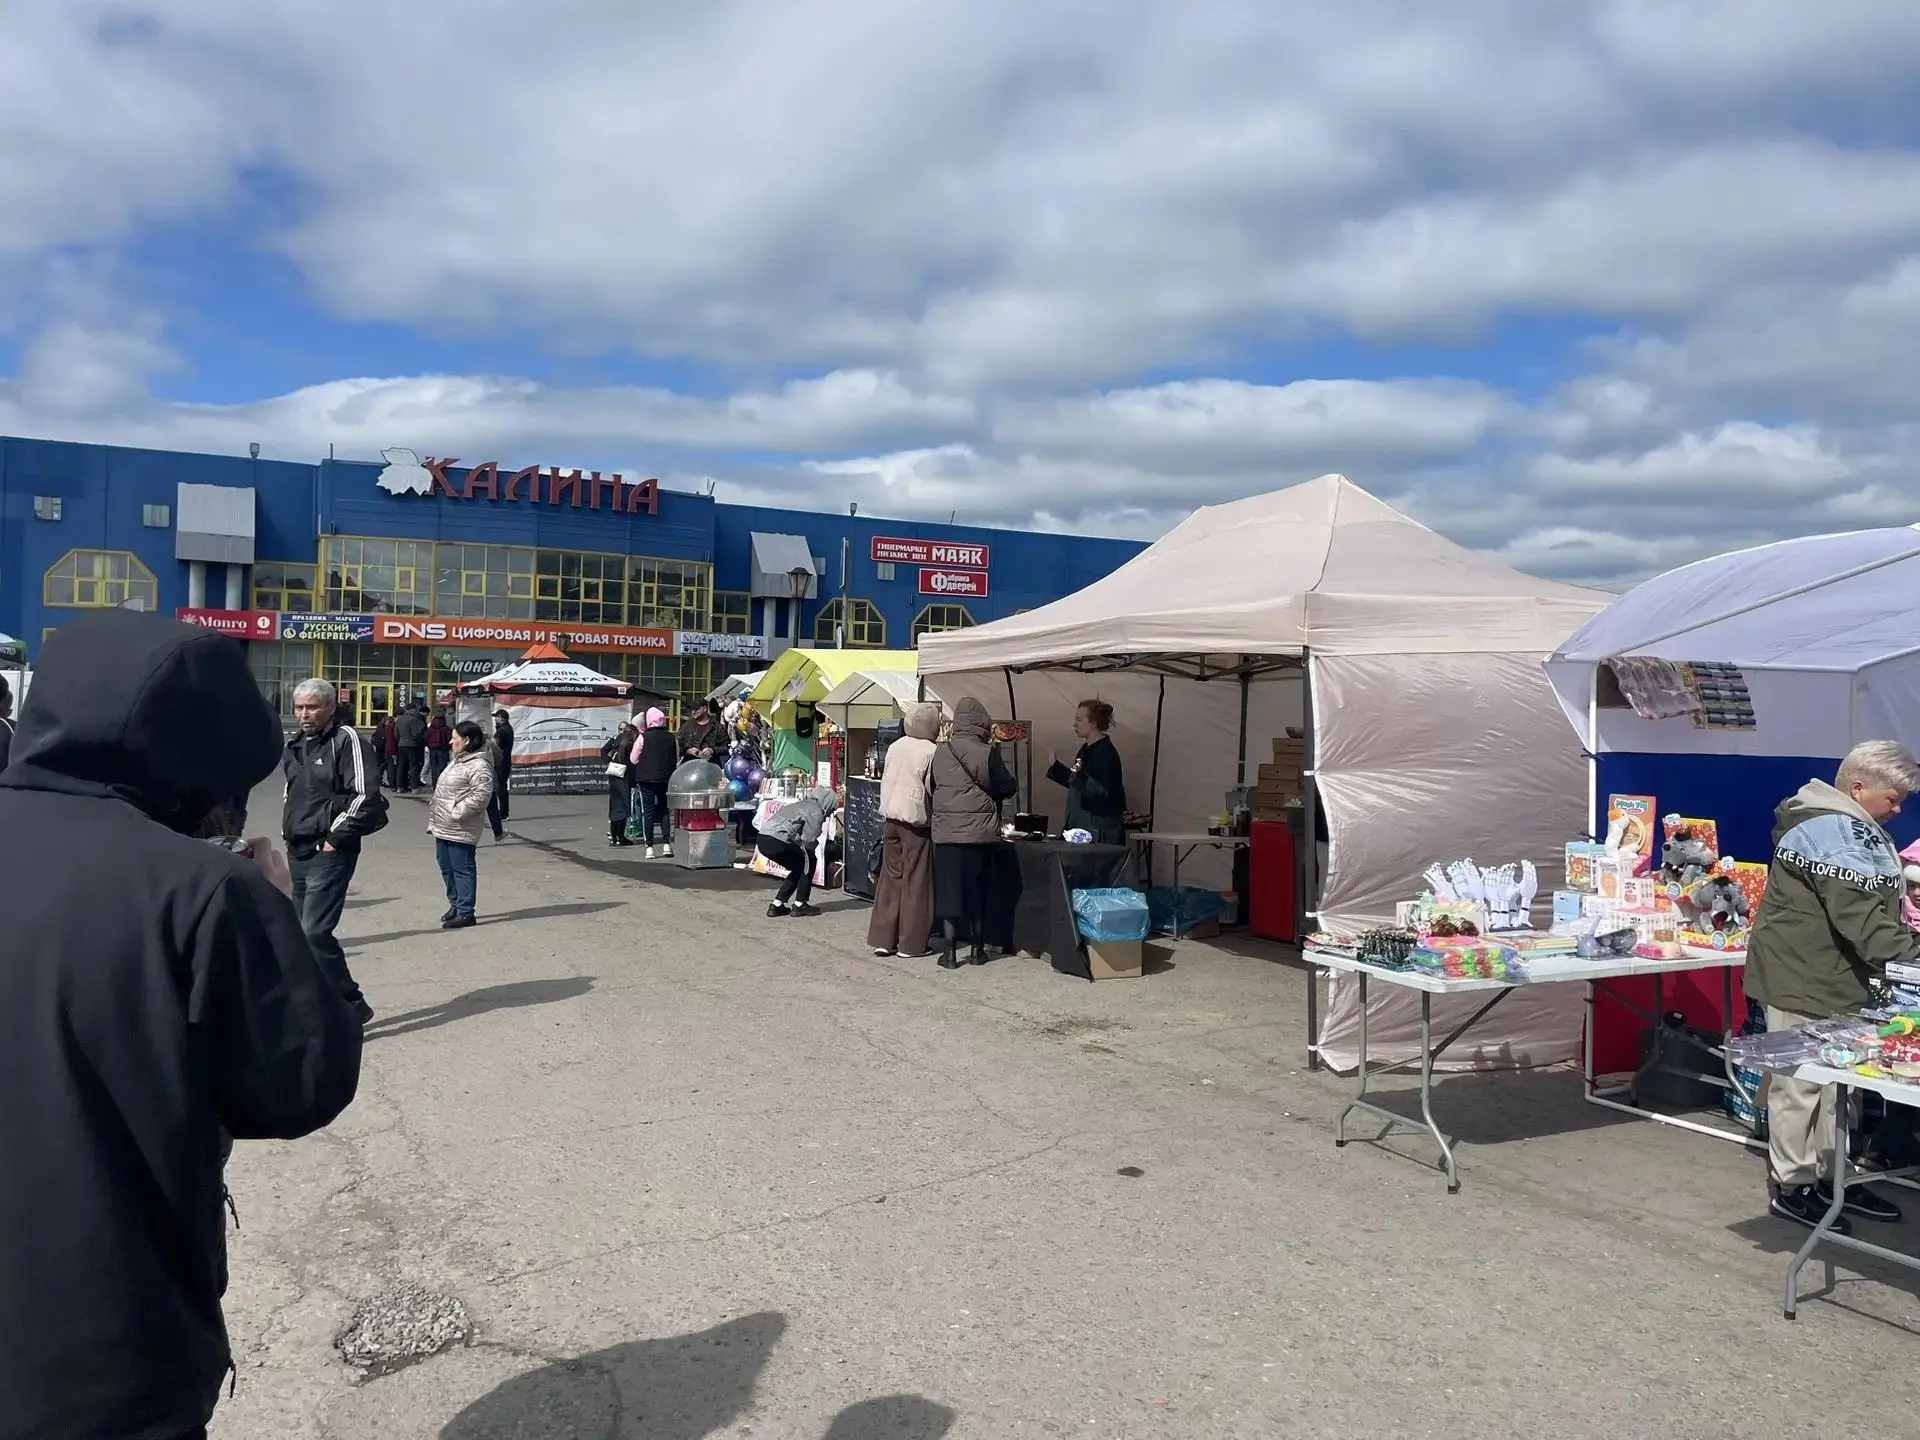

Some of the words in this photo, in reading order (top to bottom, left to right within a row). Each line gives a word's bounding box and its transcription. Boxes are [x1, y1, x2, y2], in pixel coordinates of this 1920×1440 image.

[425, 456, 658, 515] КАЛИНА
[877, 543, 927, 553] ГИПЕРМАРКЕТ
[877, 551, 908, 559] НИЗКИХ
[932, 546, 983, 565] МАЯК
[946, 581, 977, 592] дверей
[200, 616, 247, 629] Monro
[304, 622, 349, 631] РУССКИЙ
[299, 631, 357, 640] ФЕЙЕРВЕРК
[383, 621, 446, 639] DNS
[452, 626, 531, 642] ЦИФРОВАЯ
[535, 630, 545, 642] И
[550, 631, 609, 645] БТОВАЯ
[612, 634, 667, 648] ТЕХНИКА
[1811, 861, 1838, 878] LOVE
[1838, 868, 1865, 886] LOVE
